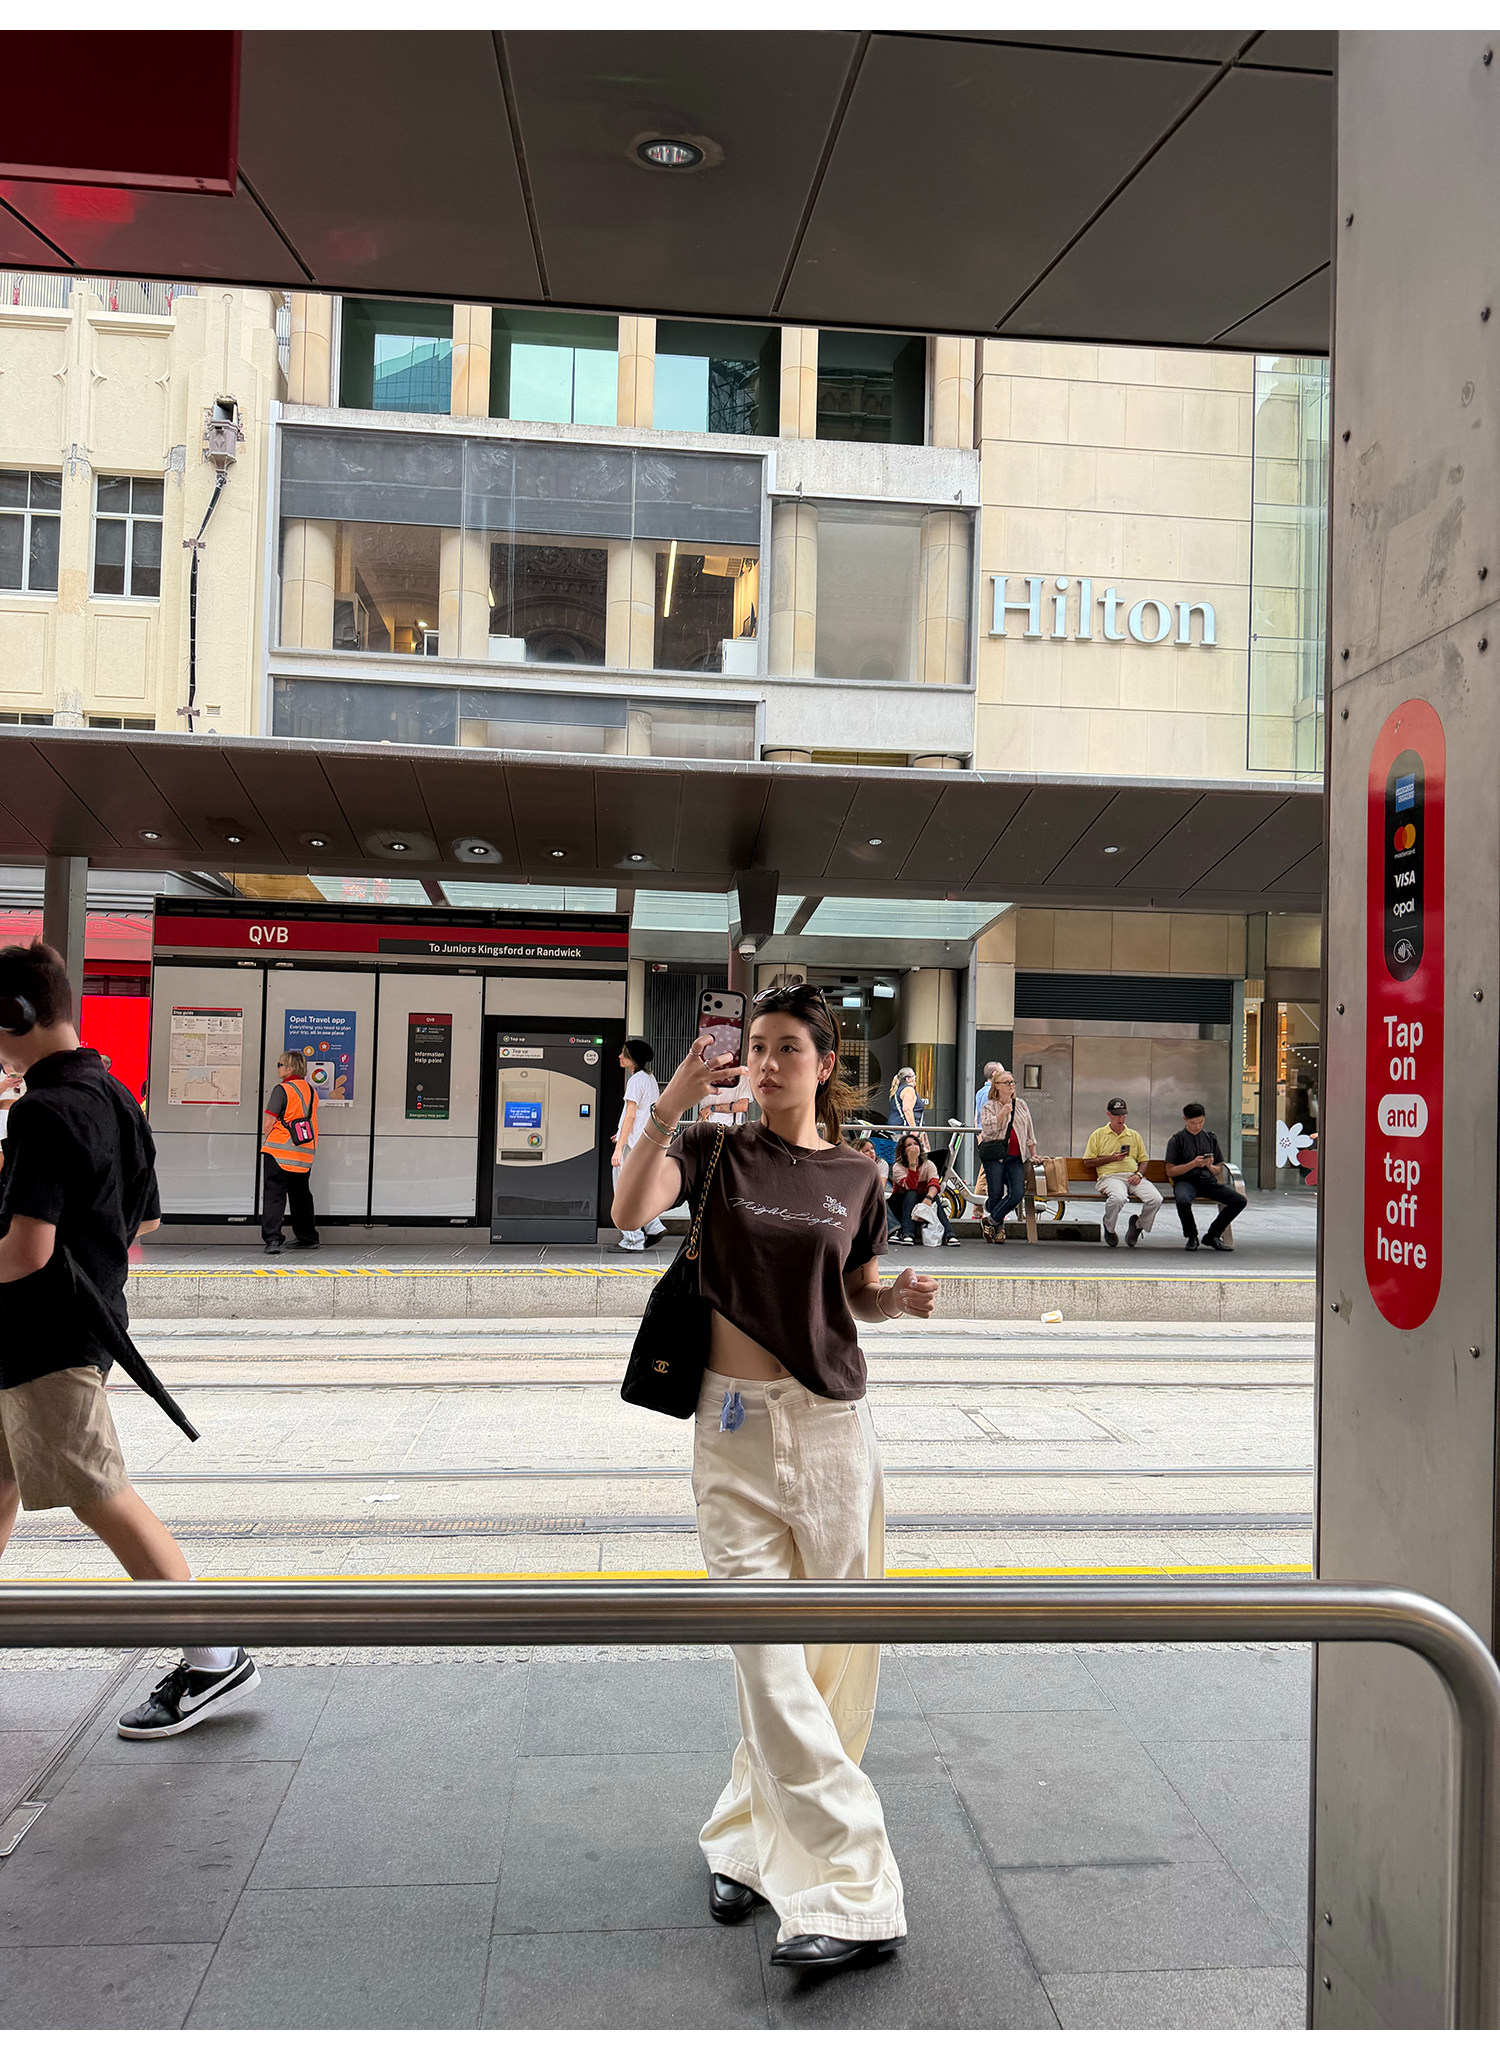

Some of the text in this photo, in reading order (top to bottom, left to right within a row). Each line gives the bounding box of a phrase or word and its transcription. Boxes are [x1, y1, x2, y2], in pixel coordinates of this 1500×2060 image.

[988, 575, 1218, 646] Hilton
[1394, 848, 1416, 859] mastercard
[1393, 870, 1416, 888] VISA
[1393, 898, 1415, 917] opal
[248, 925, 289, 945] QVB
[429, 943, 581, 957] To Juniors Kingsford or Randwick
[289, 1015, 307, 1023] Opal
[1383, 1015, 1424, 1053] Tap
[1389, 1056, 1416, 1081] on
[1386, 1102, 1418, 1128] and
[1383, 1151, 1420, 1191] tap
[1386, 1193, 1418, 1228] off
[1377, 1226, 1427, 1269] here
